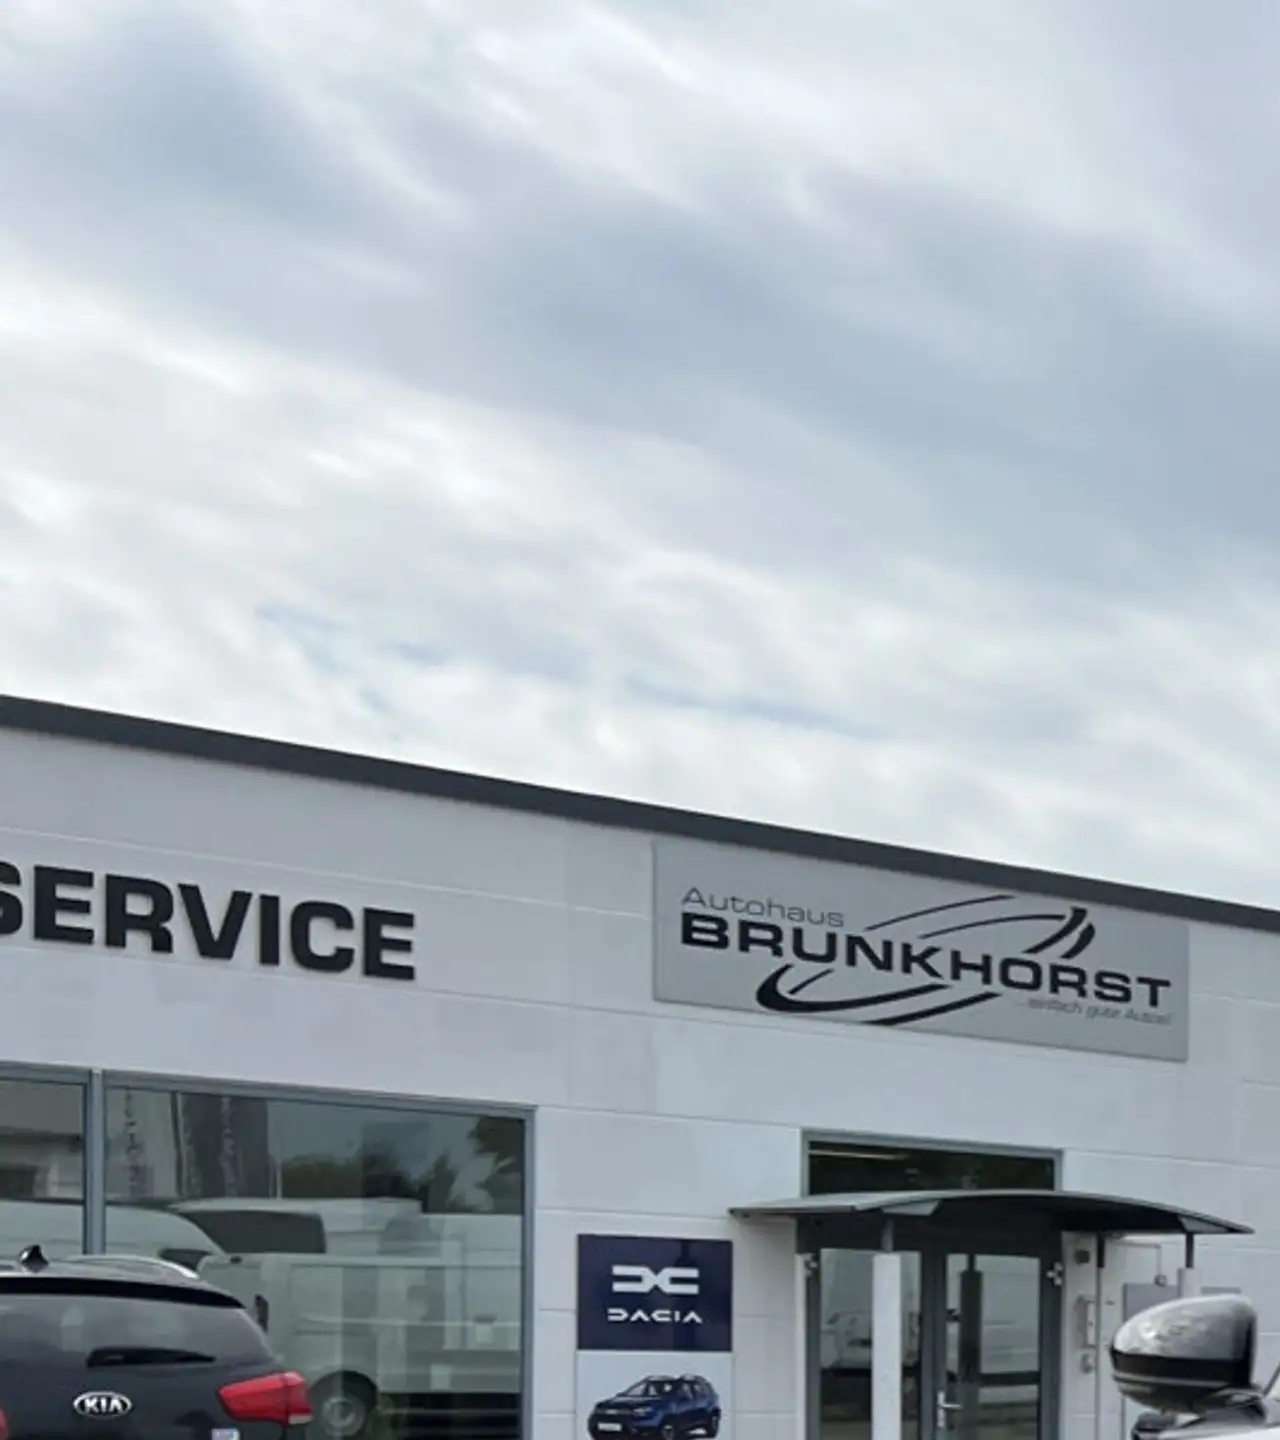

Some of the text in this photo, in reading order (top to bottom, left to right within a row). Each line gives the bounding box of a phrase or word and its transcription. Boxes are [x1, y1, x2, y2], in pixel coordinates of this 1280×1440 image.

[682, 886, 844, 928] Autohaus
[680, 910, 1172, 1008] BRUNKHORST
[607, 1307, 703, 1324] DACIA
[84, 1396, 123, 1413] KIA
